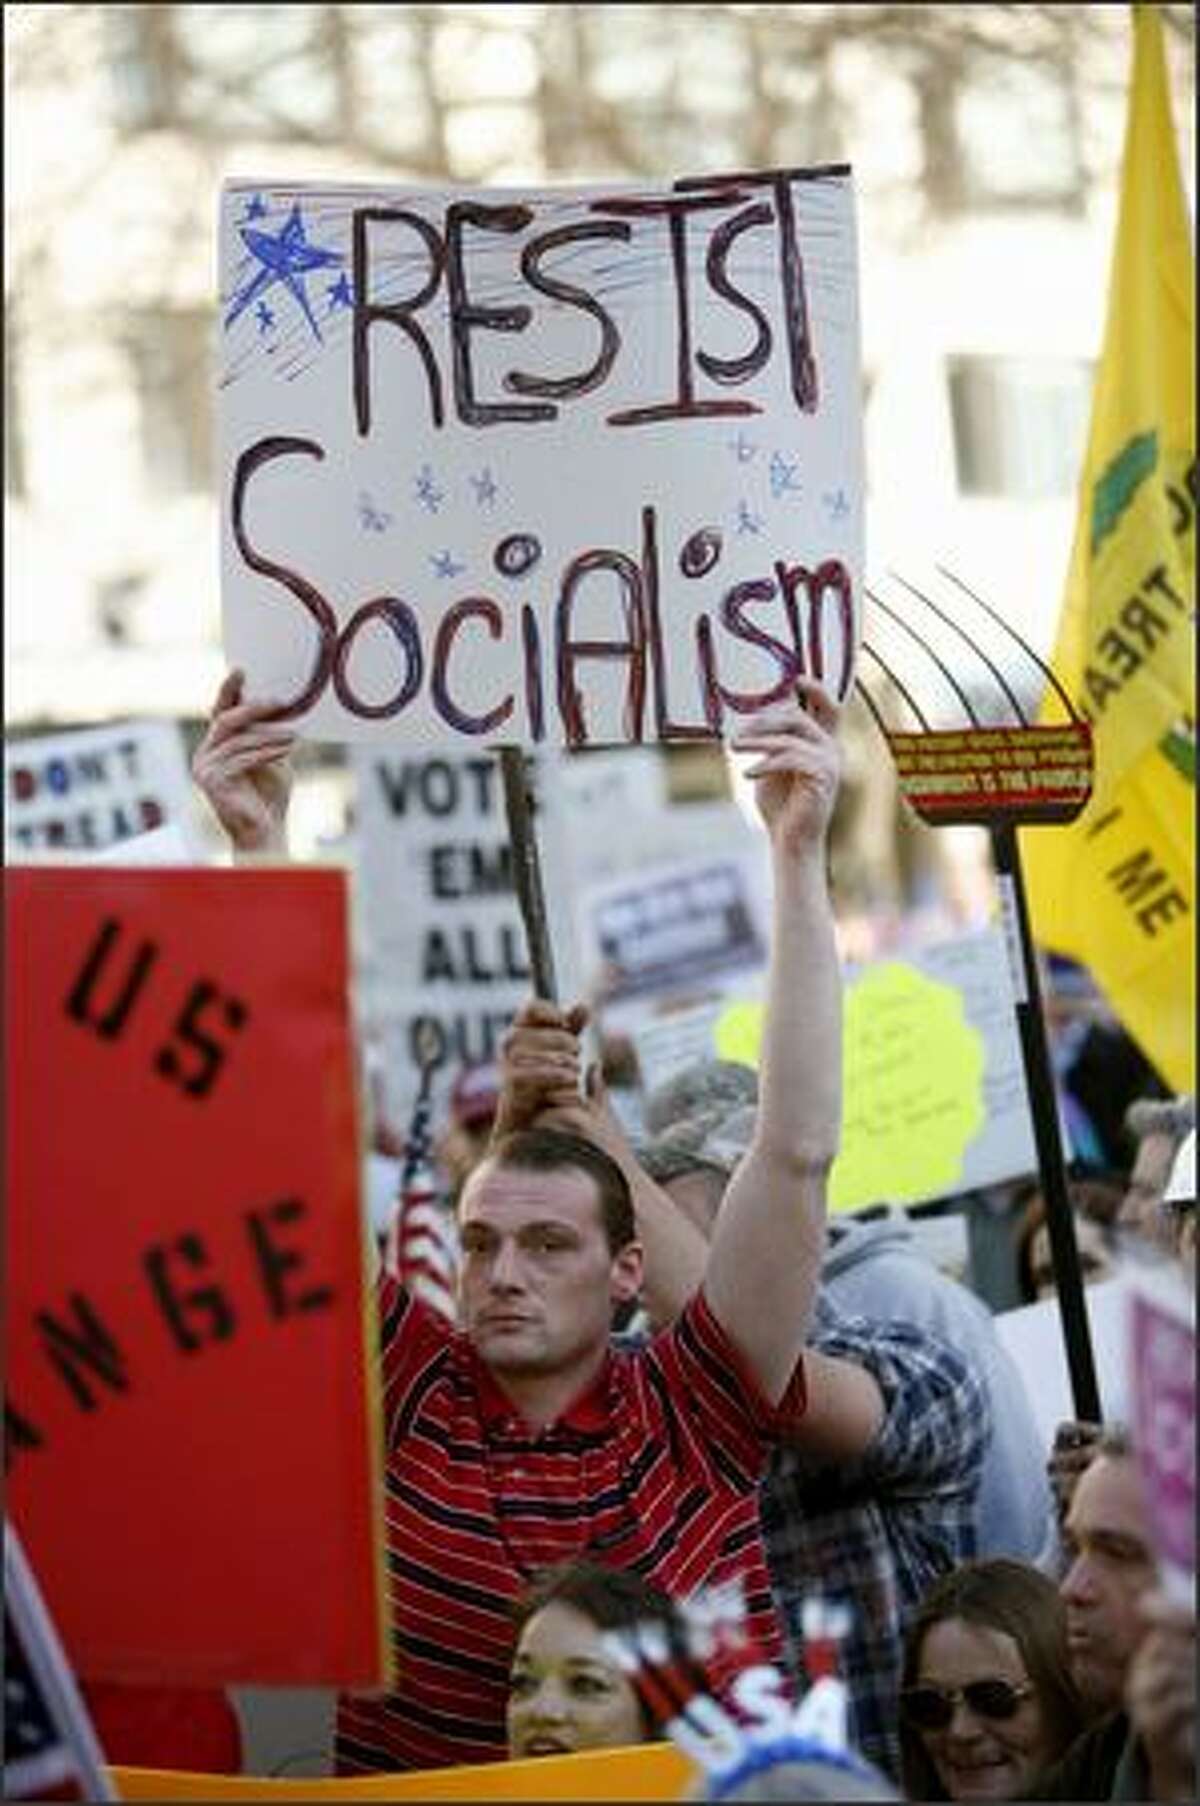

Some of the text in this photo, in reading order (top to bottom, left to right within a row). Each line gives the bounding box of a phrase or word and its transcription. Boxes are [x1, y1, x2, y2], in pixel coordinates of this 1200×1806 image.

[351, 164, 851, 437] RESIST
[1108, 848, 1188, 938] ME
[421, 926, 531, 983] ALL
[64, 916, 250, 1104] US
[408, 1012, 514, 1073] OU
[665, 1664, 849, 1779] USA
